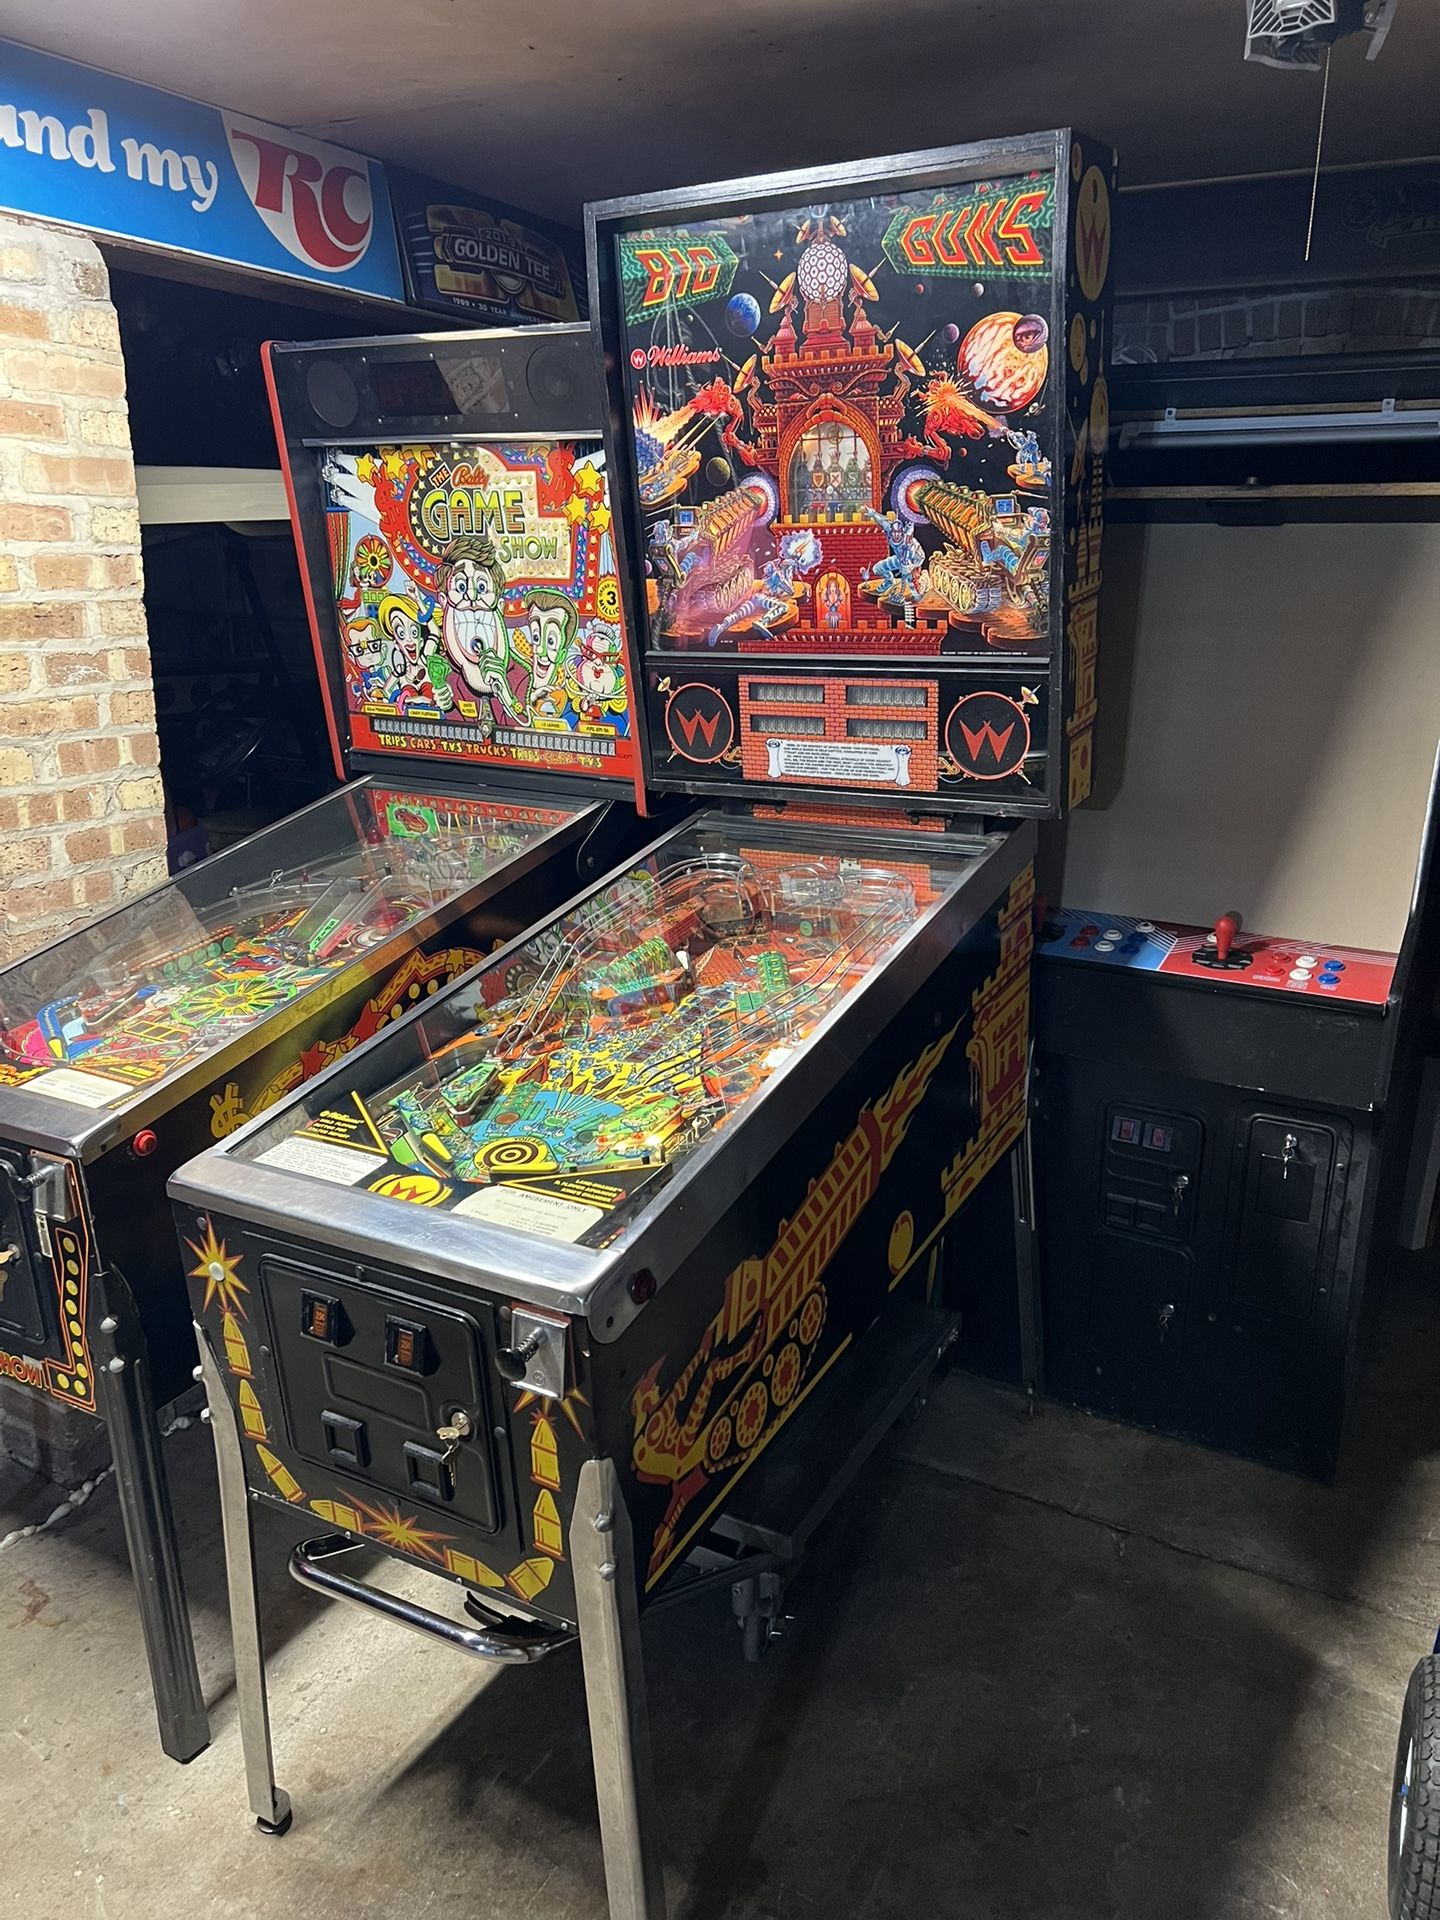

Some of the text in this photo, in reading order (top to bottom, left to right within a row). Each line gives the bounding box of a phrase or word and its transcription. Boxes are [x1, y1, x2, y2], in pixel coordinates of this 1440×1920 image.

[121, 138, 219, 213] my
[231, 129, 371, 268] RC
[900, 190, 1047, 265] GUNS
[454, 238, 550, 279] GOLDEN TEE
[635, 246, 721, 307] BIG
[647, 344, 721, 367] Williams
[431, 463, 490, 490] THE Bally
[422, 489, 525, 543] GAME
[500, 535, 558, 563] SHOW
[606, 591, 617, 606] 3
[378, 734, 407, 748] TRIPS
[410, 738, 437, 750] CARS
[466, 743, 507, 757] TRUCKS
[510, 748, 540, 762] TRIPS
[500, 1188, 517, 1197] FOR
[519, 1192, 564, 1208] AMUSEMENT
[566, 1203, 588, 1213] ONLY
